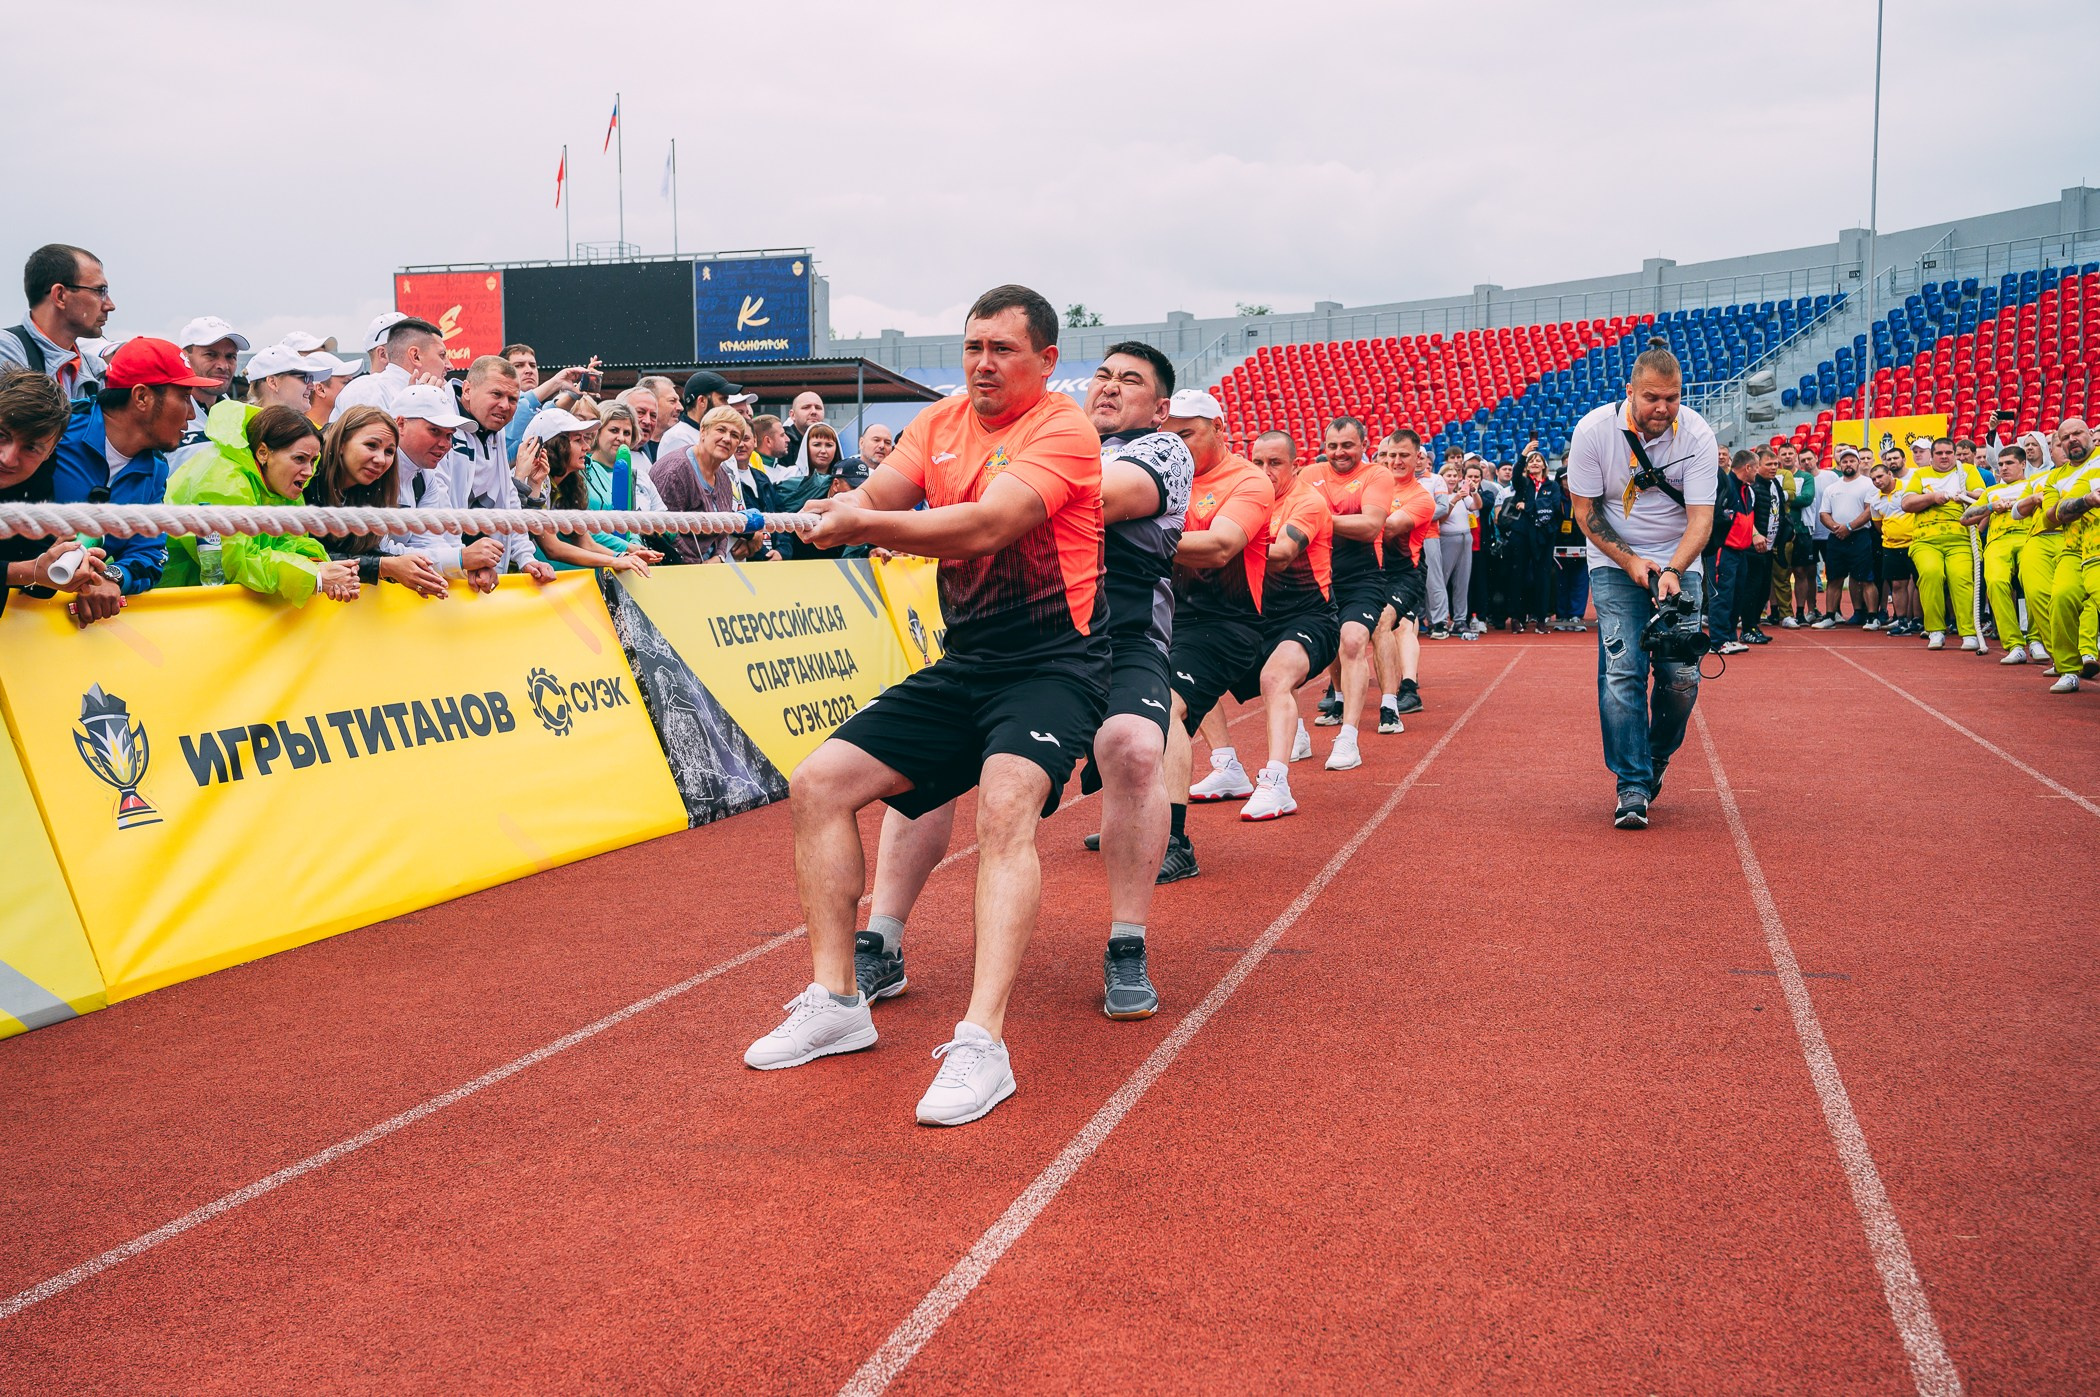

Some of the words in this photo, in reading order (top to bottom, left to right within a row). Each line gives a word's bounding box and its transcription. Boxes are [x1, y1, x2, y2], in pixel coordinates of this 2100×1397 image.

[719, 338, 789, 353] КРАСНОЯРСК
[717, 602, 848, 647] ВСЕРОССИЙСКАЯ
[746, 648, 859, 694] СПАРТАКИАДА
[569, 676, 631, 714] СУЭК
[782, 700, 828, 737] СУЭК
[823, 694, 859, 727] 2023
[178, 715, 332, 788] ИГРЫ
[328, 691, 517, 759] ТИТАНОВ
